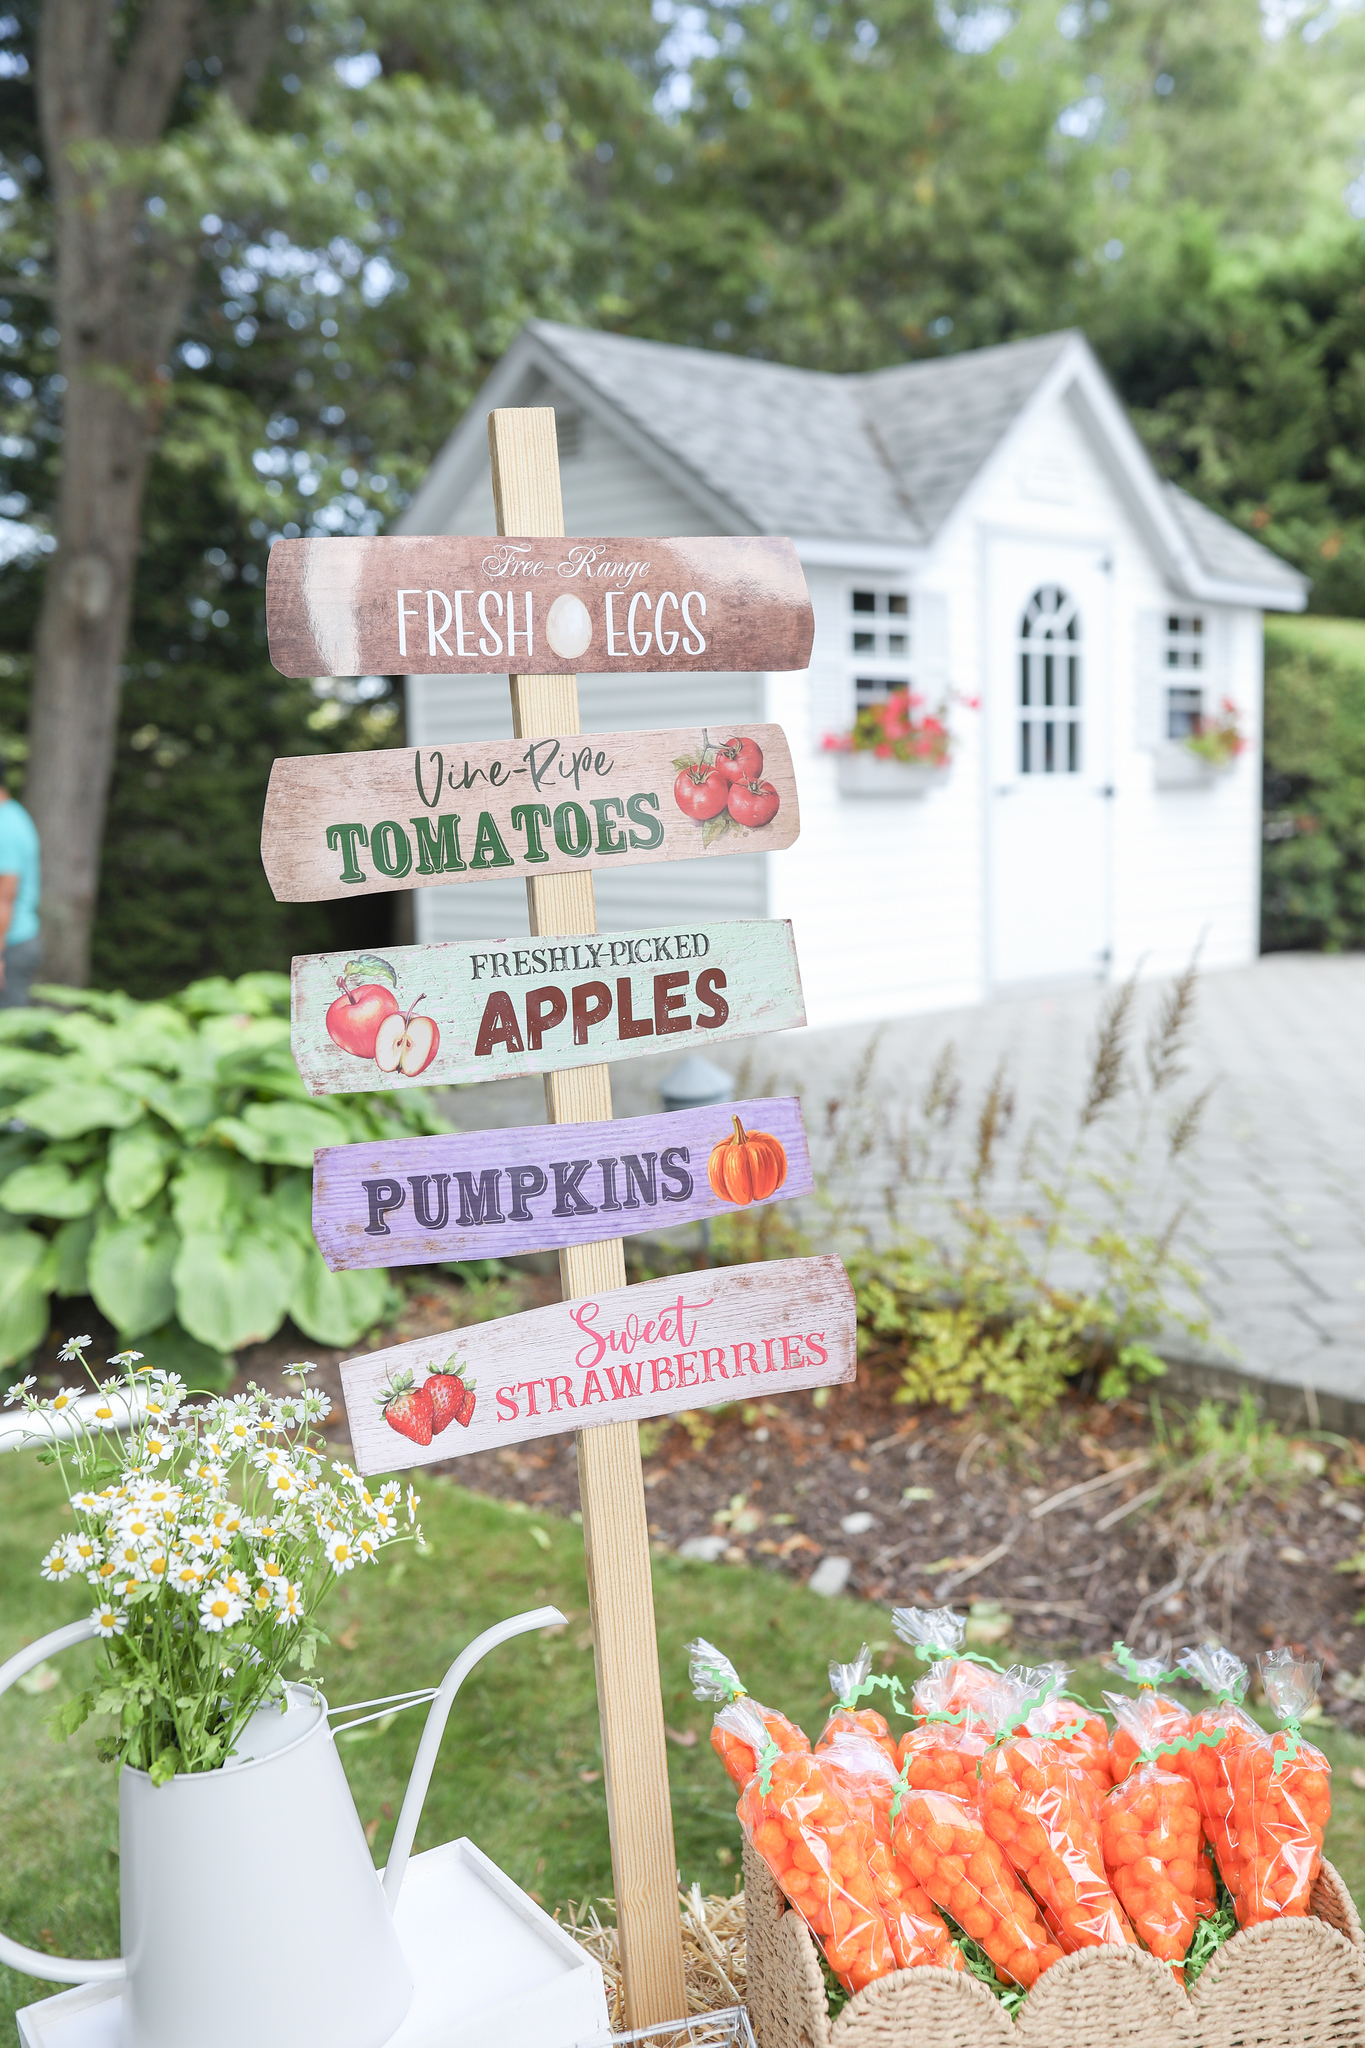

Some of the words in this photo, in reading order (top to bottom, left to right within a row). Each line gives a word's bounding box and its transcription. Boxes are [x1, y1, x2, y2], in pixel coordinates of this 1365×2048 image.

[481, 544, 652, 589] Free-Range
[397, 589, 535, 657] FRESH
[606, 590, 708, 657] EGGS
[414, 738, 615, 809] Vine-Ripe
[326, 792, 665, 884] TOMATOES
[470, 933, 711, 980] FRESHLY-PICKED
[474, 968, 730, 1057] APPLES
[361, 1146, 695, 1236] PUMPKINS
[569, 1295, 714, 1368] Sweet
[495, 1332, 829, 1423] STRAWBERRIES
